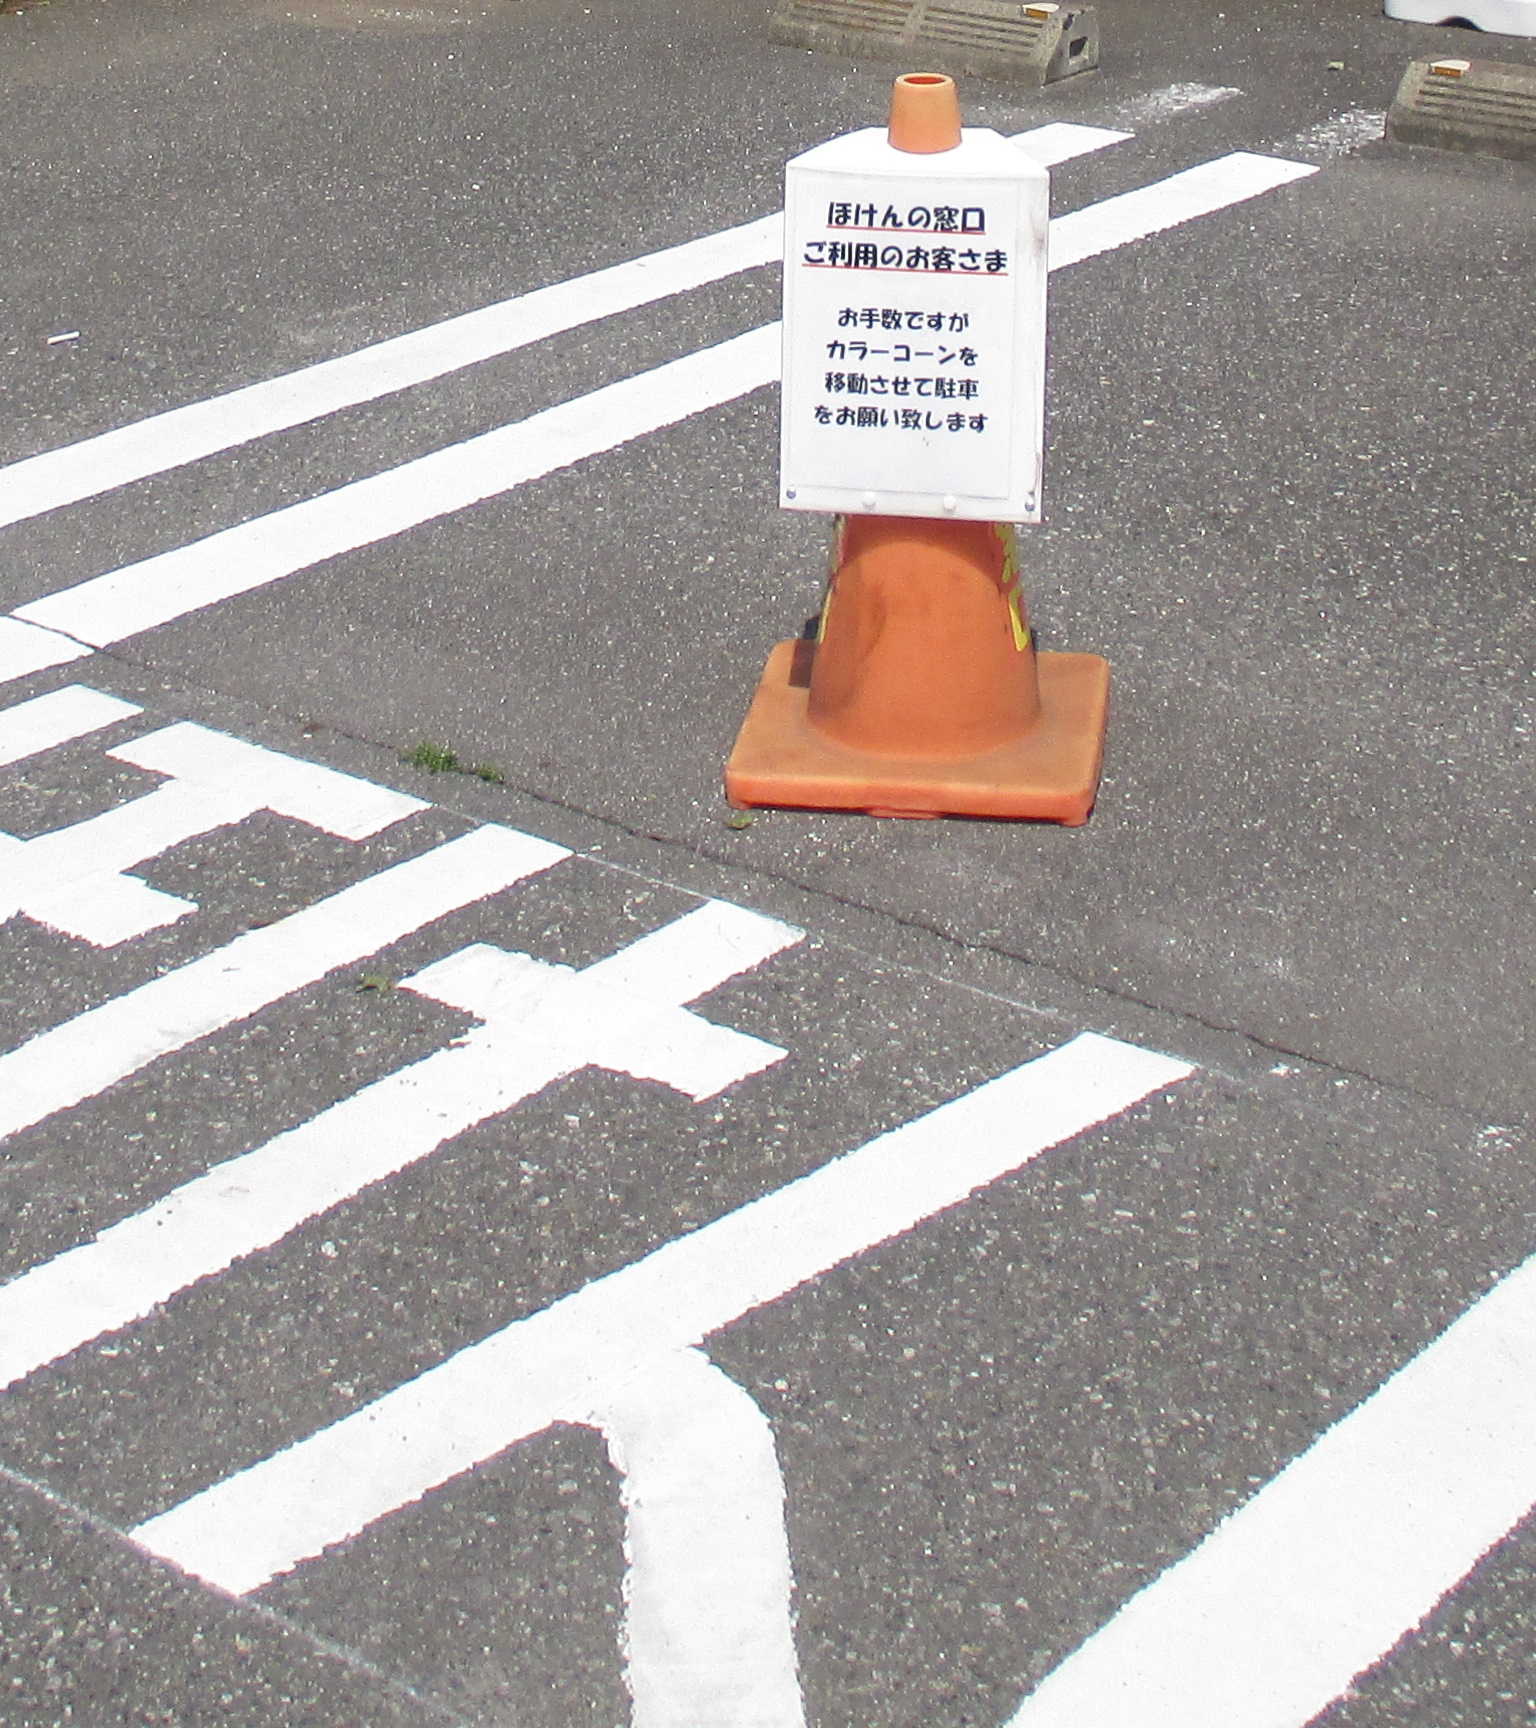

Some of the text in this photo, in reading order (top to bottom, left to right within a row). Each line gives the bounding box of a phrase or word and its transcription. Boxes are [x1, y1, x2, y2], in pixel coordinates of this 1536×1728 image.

[827, 201, 986, 233] ほけんの窓口
[802, 240, 1009, 273] ご利用のお客さま
[837, 307, 970, 333] お手数ですが
[827, 340, 979, 368] カラーコーンを
[825, 371, 980, 400] 移動させて駐車
[814, 404, 989, 434] をお願い致します
